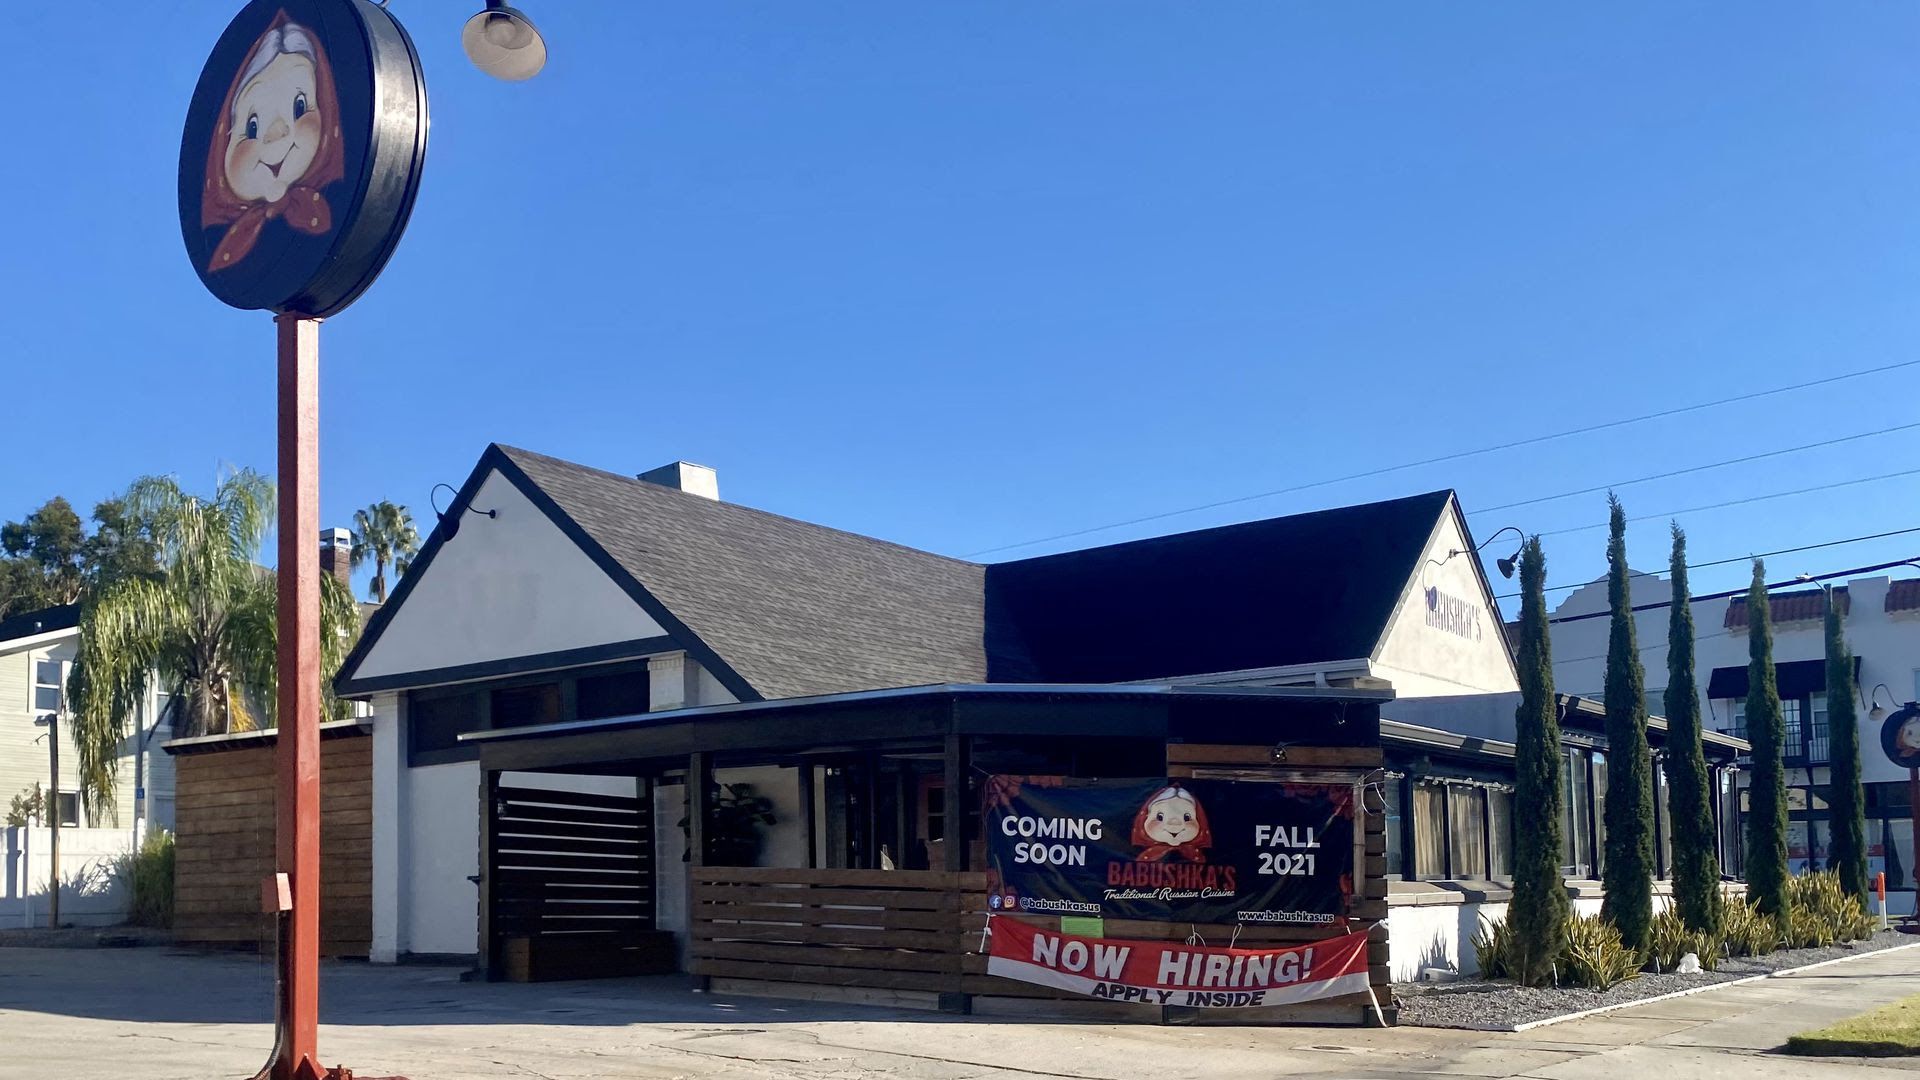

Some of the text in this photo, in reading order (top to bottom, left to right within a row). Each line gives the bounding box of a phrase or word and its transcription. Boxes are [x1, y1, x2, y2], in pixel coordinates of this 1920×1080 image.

[1001, 815, 1102, 841] COMING
[1255, 824, 1321, 848] FALL
[1014, 842, 1086, 866] SOON
[1258, 852, 1315, 876] 2021
[1107, 861, 1237, 890] BABUSHKA'S
[1019, 897, 1100, 912] @babushkas.us
[1103, 886, 1235, 901] Traditional Russian Cuisine
[1237, 910, 1335, 923] www.babushkas.us
[1032, 933, 1314, 987] NOW HIRING!
[1091, 982, 1267, 1007] APPLY INSIDE
